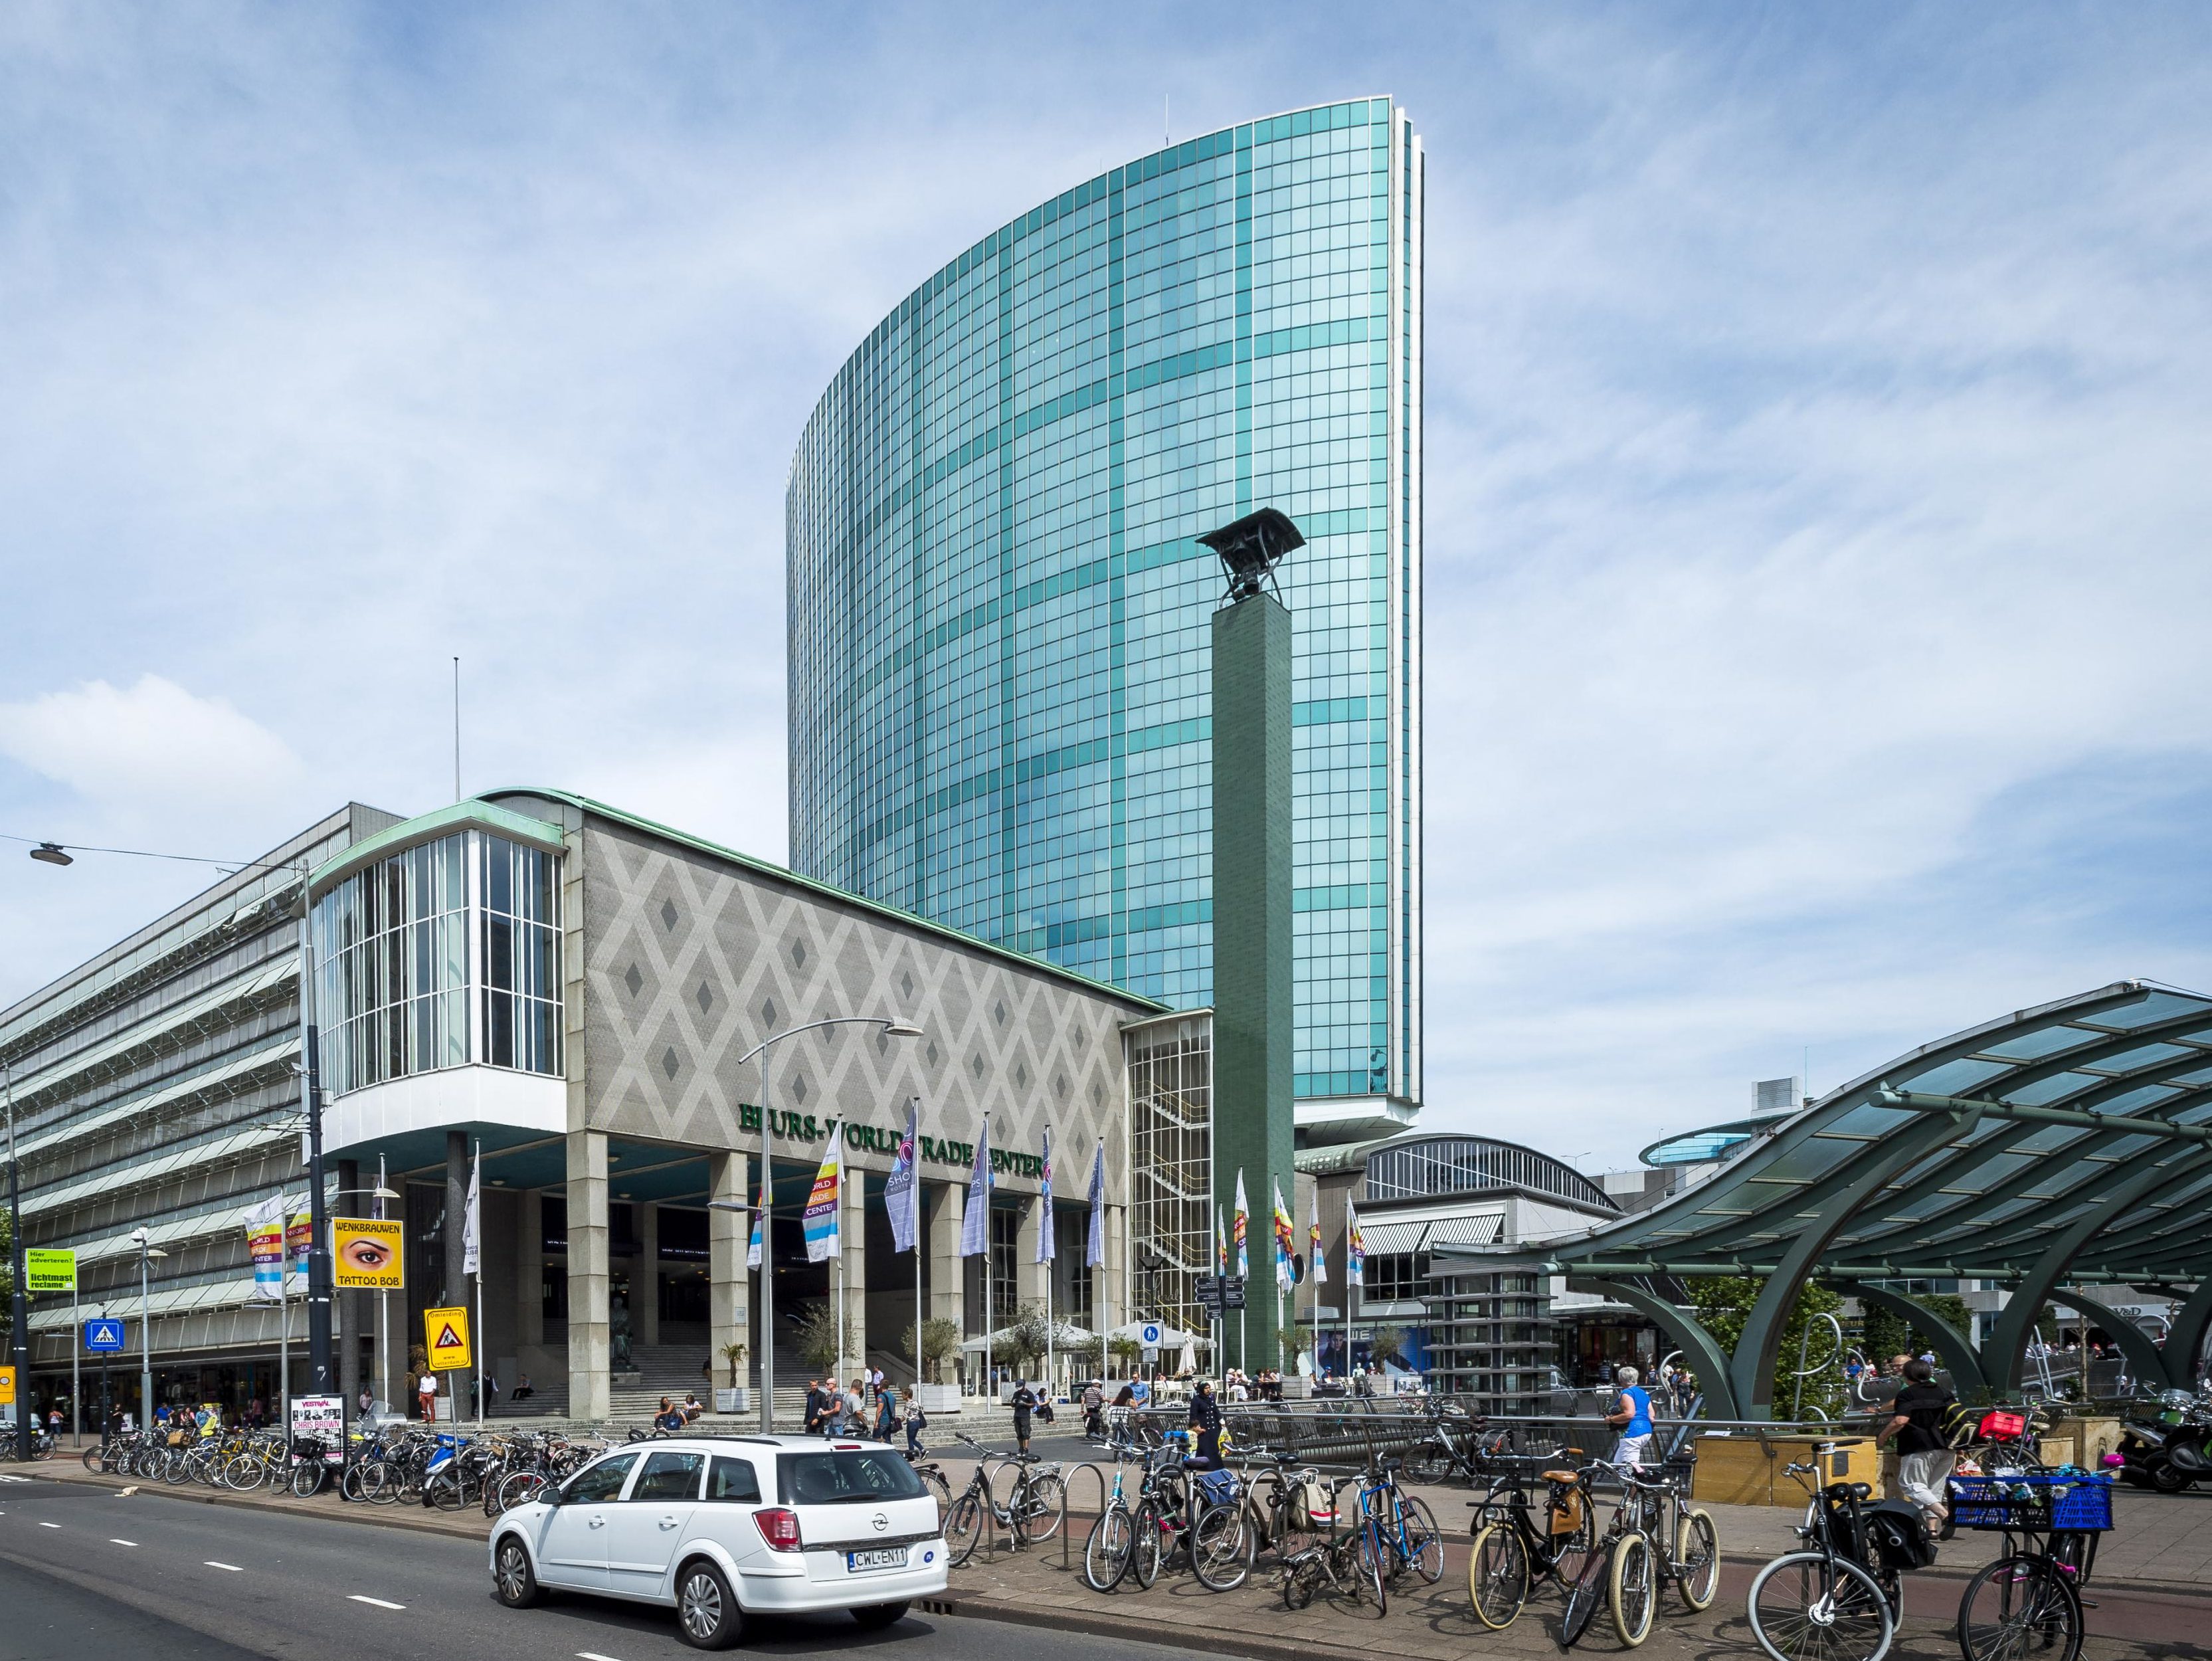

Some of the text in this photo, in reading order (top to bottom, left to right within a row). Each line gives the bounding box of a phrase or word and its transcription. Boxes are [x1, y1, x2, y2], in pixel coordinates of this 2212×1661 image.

[988, 1147, 1044, 1177] ENTER
[888, 1171, 911, 1186] SHO
[808, 1193, 830, 1204] RADE
[335, 1222, 400, 1234] WENKBRAUWEN
[339, 1276, 399, 1286] TATTOO BOB
[2114, 1307, 2142, 1316] V&D
[315, 1420, 339, 1428] BROWN
[856, 1548, 905, 1566] CWL EN11
